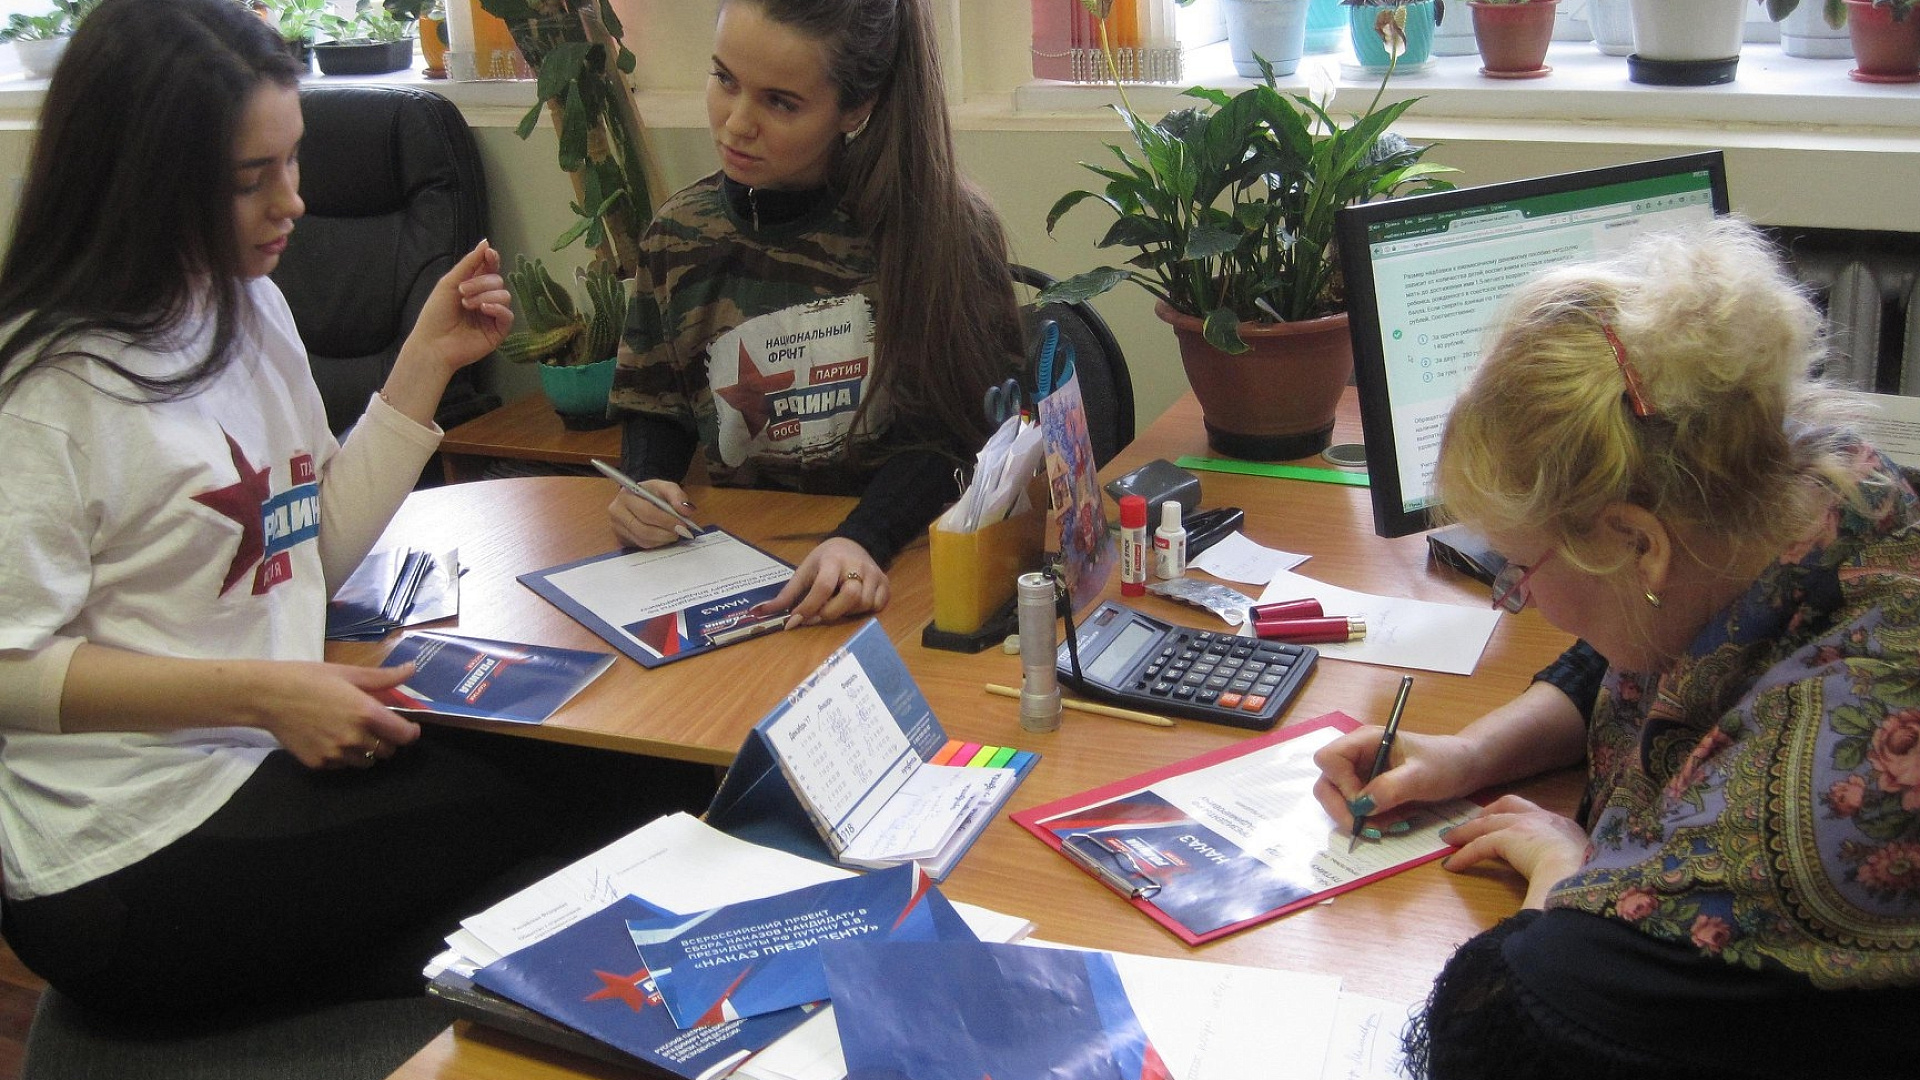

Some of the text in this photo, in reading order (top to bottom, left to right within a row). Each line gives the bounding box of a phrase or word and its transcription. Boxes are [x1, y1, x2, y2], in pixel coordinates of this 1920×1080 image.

[815, 362, 862, 380] ПАРТИЯ
[773, 423, 800, 439] РОСС
[264, 495, 320, 547] РДИН
[701, 597, 750, 616] НАКАЗ
[459, 658, 496, 694] РОДИНА
[1179, 834, 1230, 865] НАКАЗ
[681, 909, 829, 947] ВСЕРОССИЙСКИЙ ПРОЕКТ
[684, 940, 723, 953] СБОРА
[726, 928, 782, 944] НАКАЗОВ
[784, 912, 855, 933] КАНДИДАТУ
[688, 917, 865, 960] ПРЕЗИДЕНТЫ РФ ПУТИНУ В.В.
[694, 950, 759, 970] «НАКАЗ
